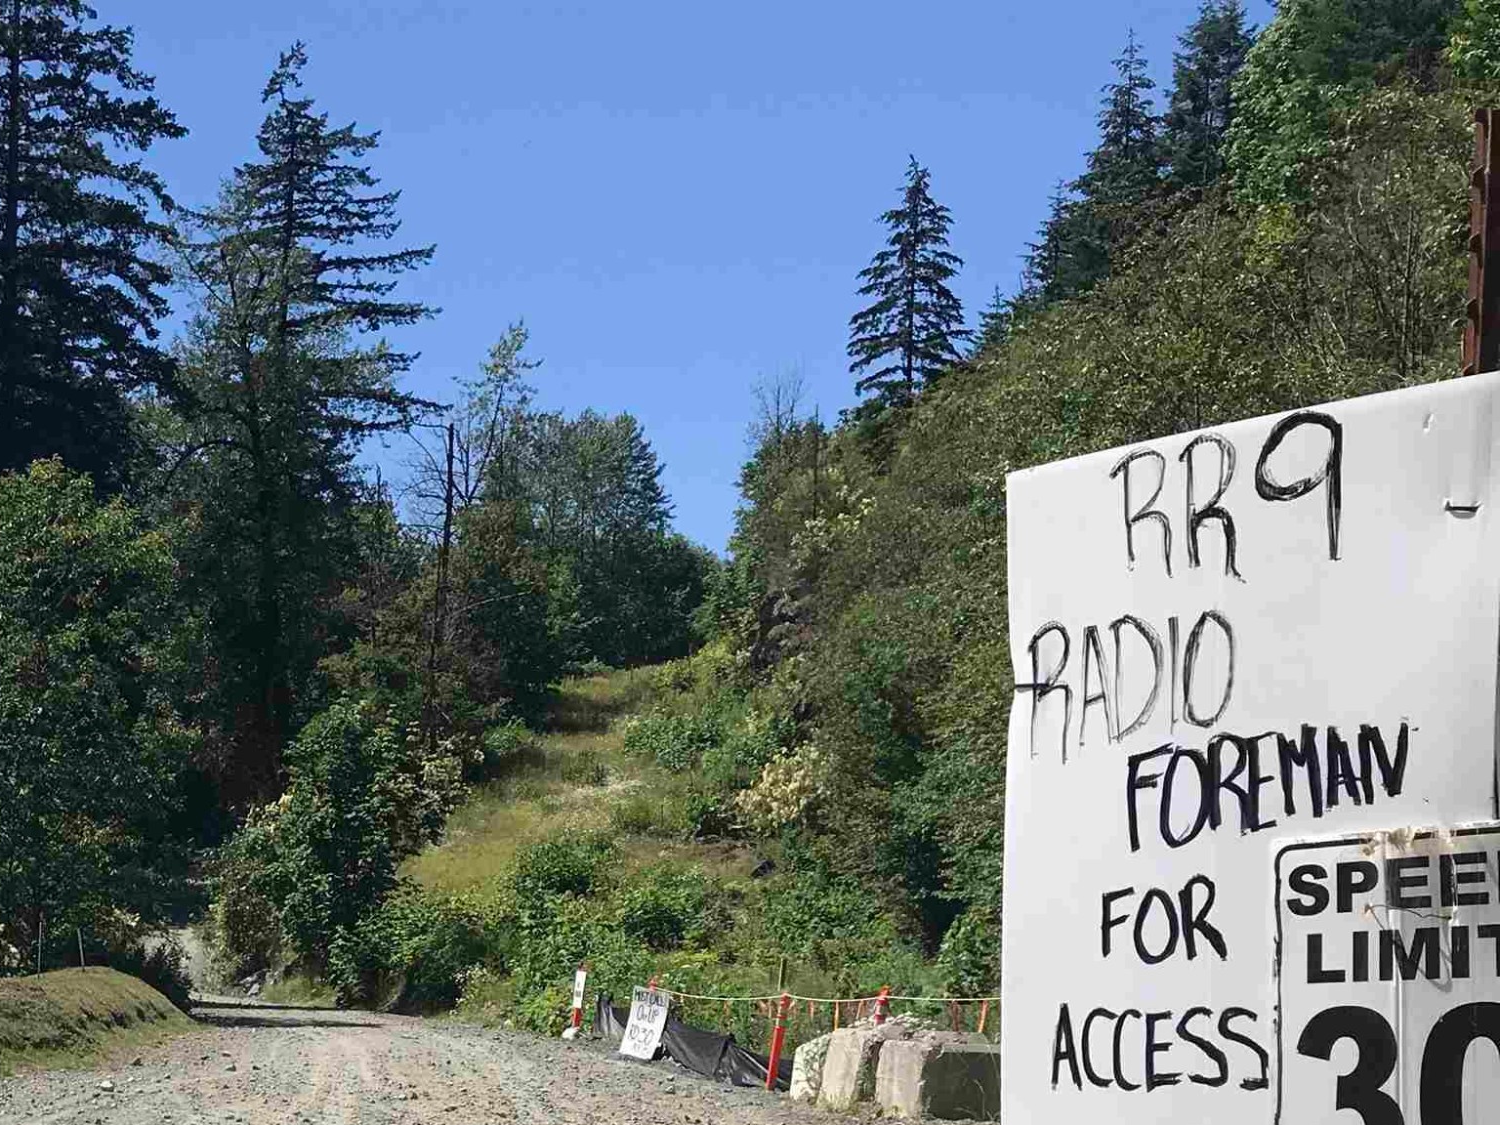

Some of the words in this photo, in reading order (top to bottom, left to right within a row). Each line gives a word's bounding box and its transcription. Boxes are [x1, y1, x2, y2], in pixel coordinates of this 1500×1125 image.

[1027, 609, 1236, 766] RADIO
[1126, 717, 1412, 852] FOREMAN
[1100, 873, 1229, 965] FOR
[1285, 849, 1500, 917] SPEE
[1050, 1003, 1269, 1092] ACCESS
